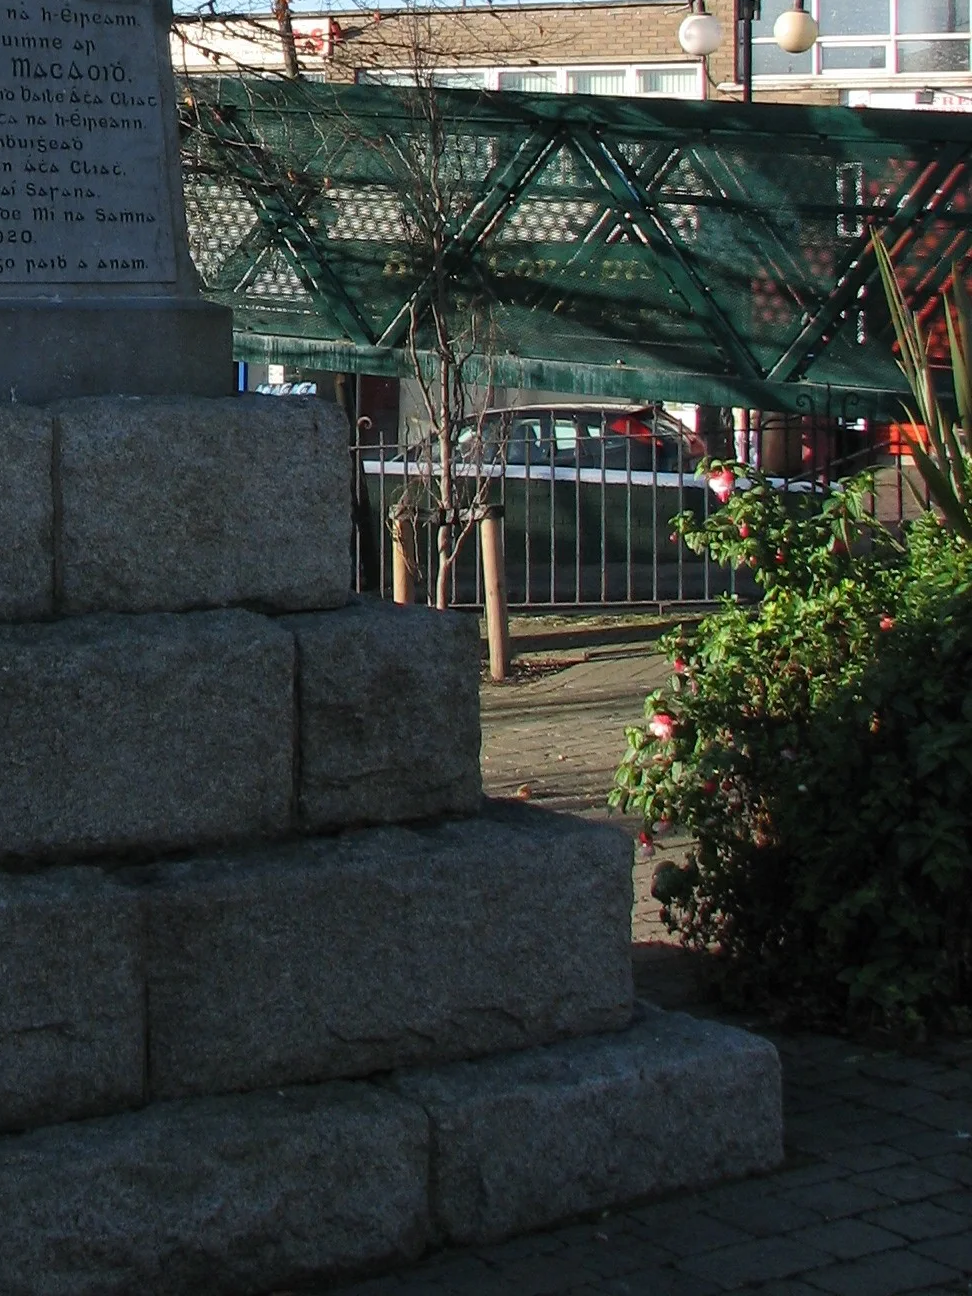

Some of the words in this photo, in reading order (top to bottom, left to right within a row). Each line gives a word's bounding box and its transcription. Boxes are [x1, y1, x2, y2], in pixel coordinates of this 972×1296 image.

[26, 114, 47, 126] na
[64, 211, 85, 222] na
[77, 258, 88, 270] a
